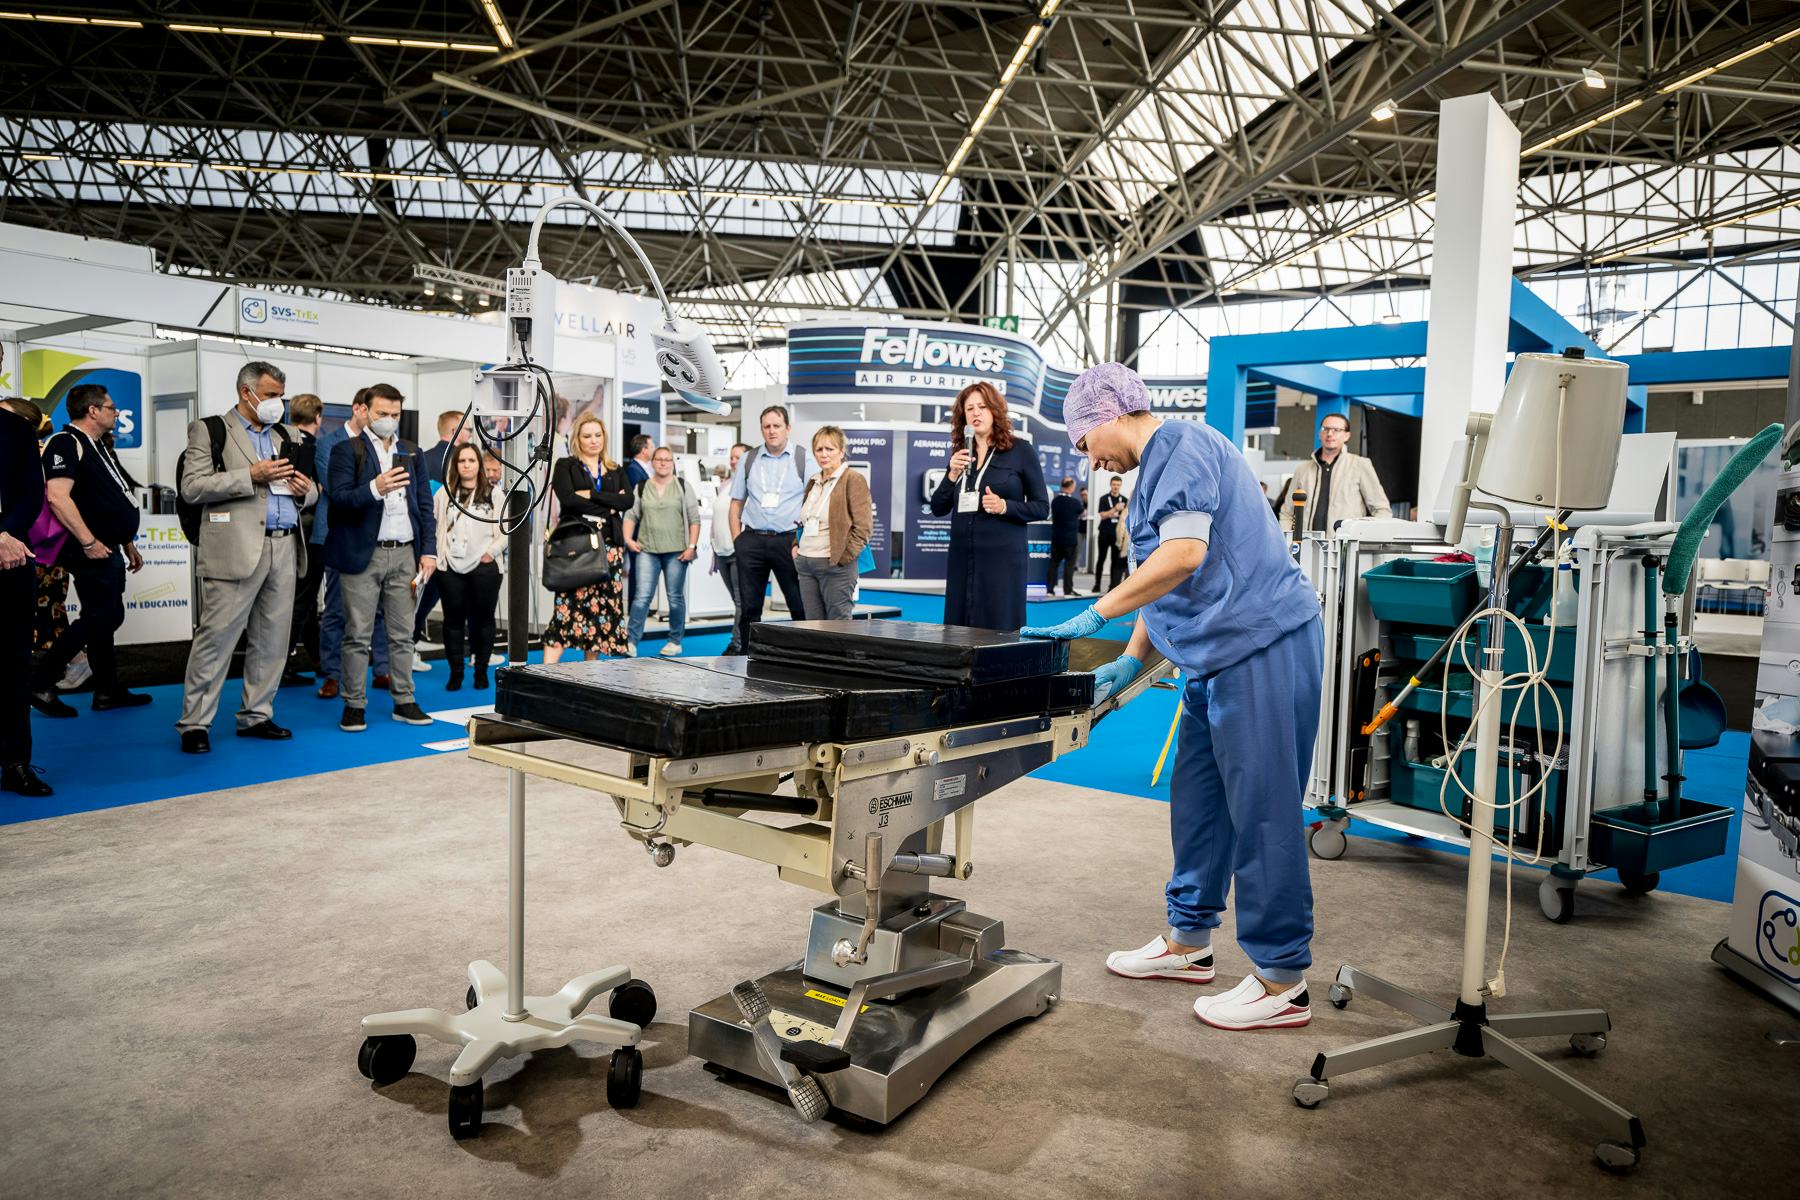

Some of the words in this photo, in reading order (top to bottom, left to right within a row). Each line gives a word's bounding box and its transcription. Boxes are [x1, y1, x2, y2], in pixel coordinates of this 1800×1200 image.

[271, 306, 318, 321] SVS-TrEx
[860, 327, 1006, 372] Fellowes
[861, 374, 893, 384] AIR
[911, 375, 1004, 391] PURIFIS
[870, 438, 886, 446] PRO
[140, 599, 188, 609] EDUCATION
[879, 793, 913, 809] ESCHMANN
[879, 815, 889, 826] J3
